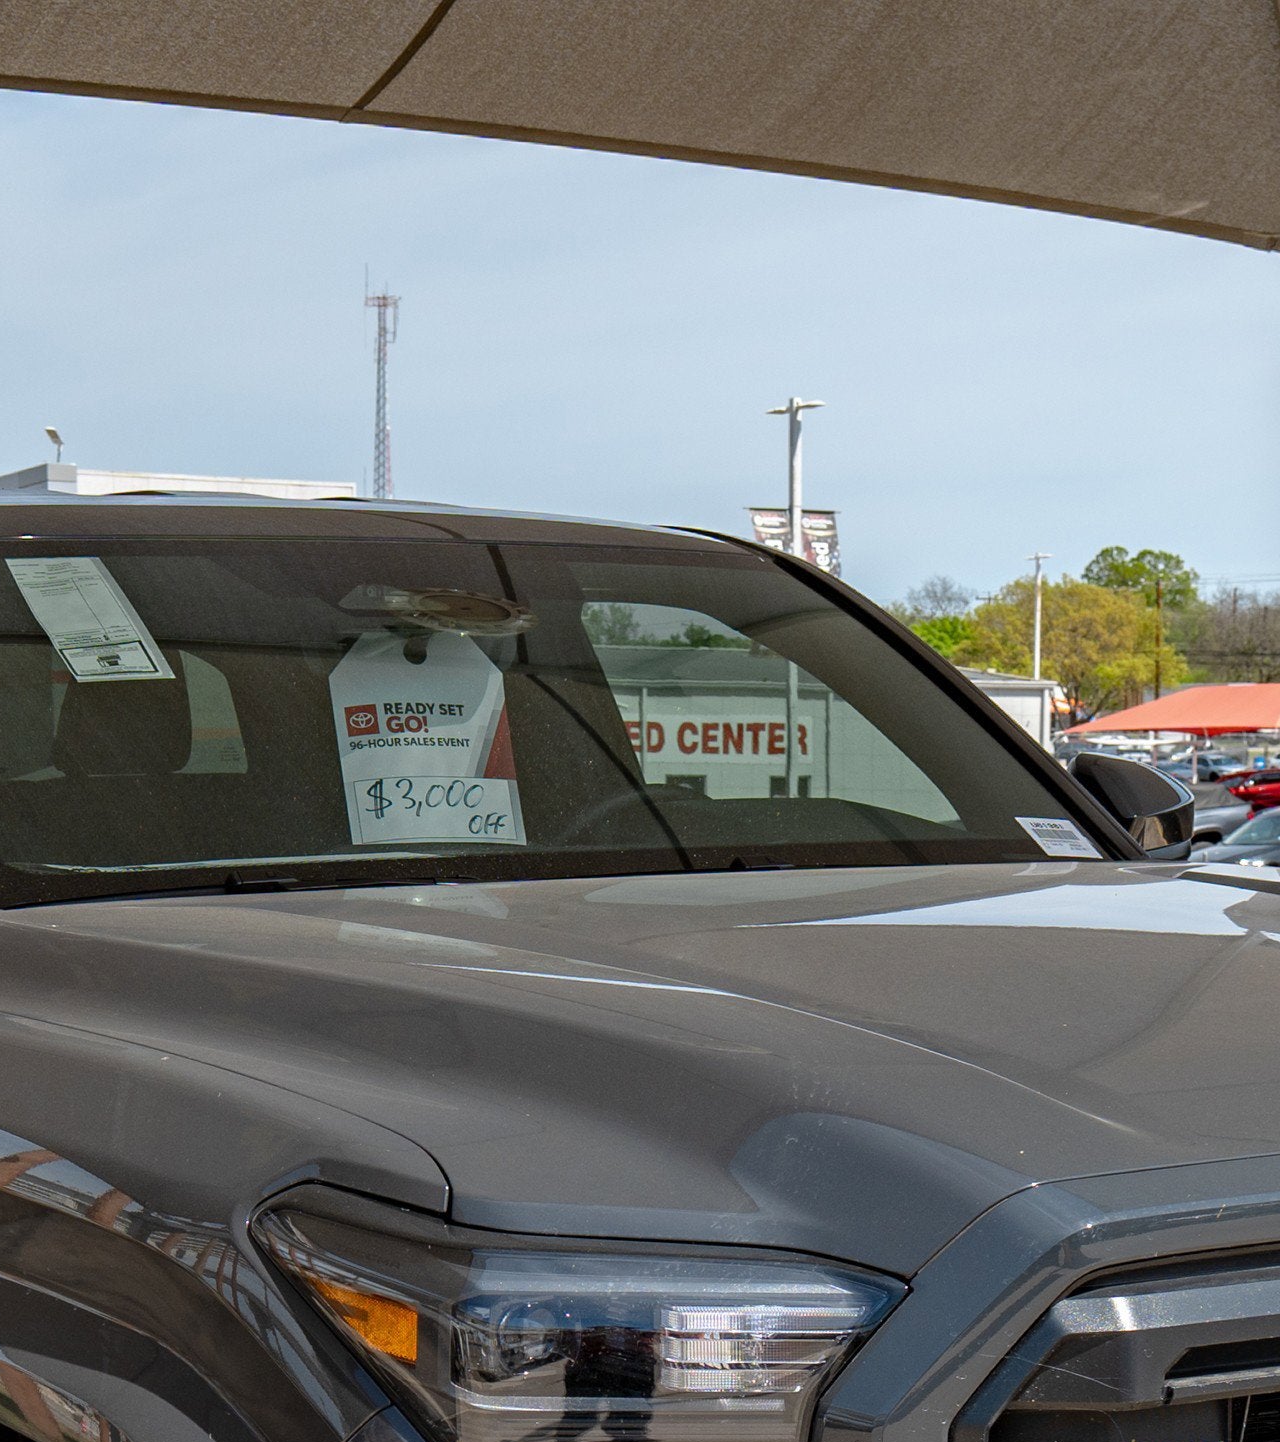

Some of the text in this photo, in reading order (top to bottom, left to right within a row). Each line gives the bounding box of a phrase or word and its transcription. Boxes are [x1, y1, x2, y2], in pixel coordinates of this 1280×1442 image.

[383, 703, 465, 717] READY SET
[386, 715, 430, 734] GO!
[349, 737, 470, 750] 96-HOUR SALES EVENT
[365, 778, 485, 819] $3,000
